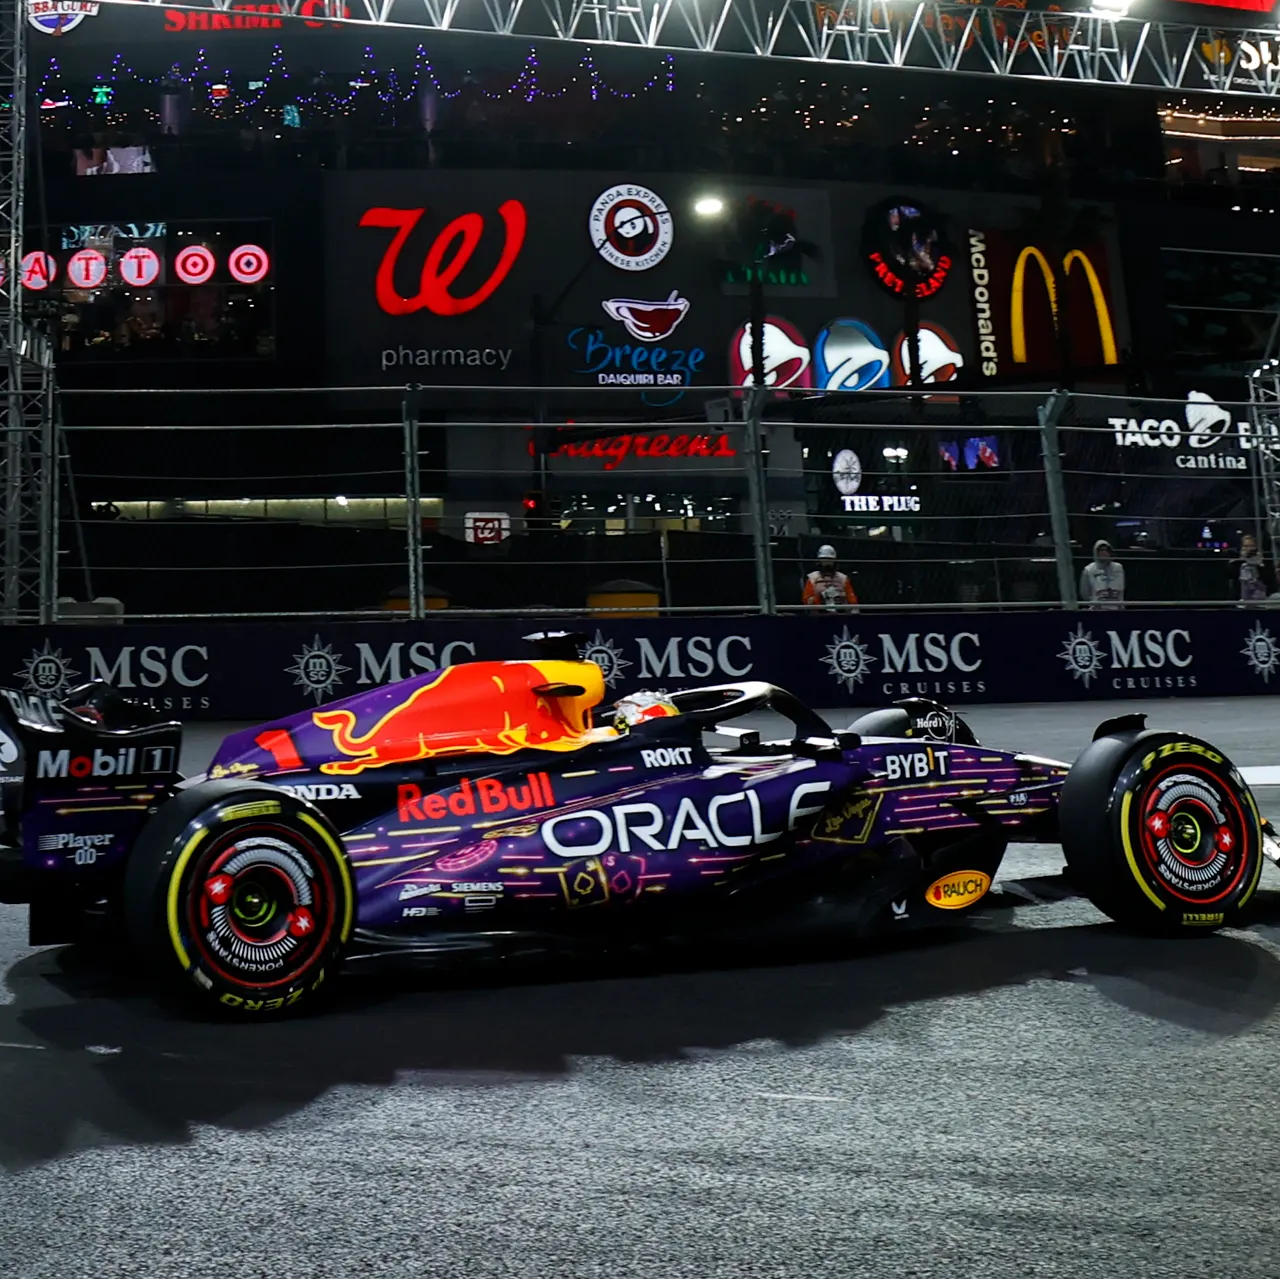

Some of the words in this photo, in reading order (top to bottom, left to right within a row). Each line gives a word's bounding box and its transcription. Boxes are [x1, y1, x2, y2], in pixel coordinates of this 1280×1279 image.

[593, 189, 624, 222] PANDA
[635, 240, 669, 268] KITCHEN
[969, 229, 998, 377] McDonald's
[381, 345, 513, 370] pharmacy
[567, 328, 705, 406] Breeze
[598, 373, 654, 385] DAIQUIRI
[657, 374, 682, 385] BAR
[1108, 418, 1182, 447] TACO
[1176, 452, 1247, 470] cantina
[841, 496, 879, 512] THE
[882, 496, 920, 512] PLUG
[635, 636, 754, 679] MSC
[879, 632, 983, 674] MSC
[1107, 629, 1193, 669] MSC
[85, 645, 209, 688] MSC
[883, 681, 987, 696] CRUISES
[1112, 676, 1198, 689] CRUISES
[916, 717, 938, 728] Hard
[36, 747, 136, 778] Mobil
[151, 749, 163, 771] 1
[253, 728, 305, 769] 1
[640, 747, 693, 768] ROKT
[1161, 742, 1224, 764] ZERO
[886, 747, 948, 780] BYBIT
[278, 784, 362, 801] NDA
[397, 778, 476, 822] Red
[477, 772, 555, 813] Bull
[541, 781, 831, 858] ORACLE
[57, 833, 115, 849] Player
[451, 881, 504, 892] SIEMENS
[943, 877, 983, 899] RAUCH
[206, 931, 284, 972] POKERSTARS
[219, 987, 305, 1011] ZERO
